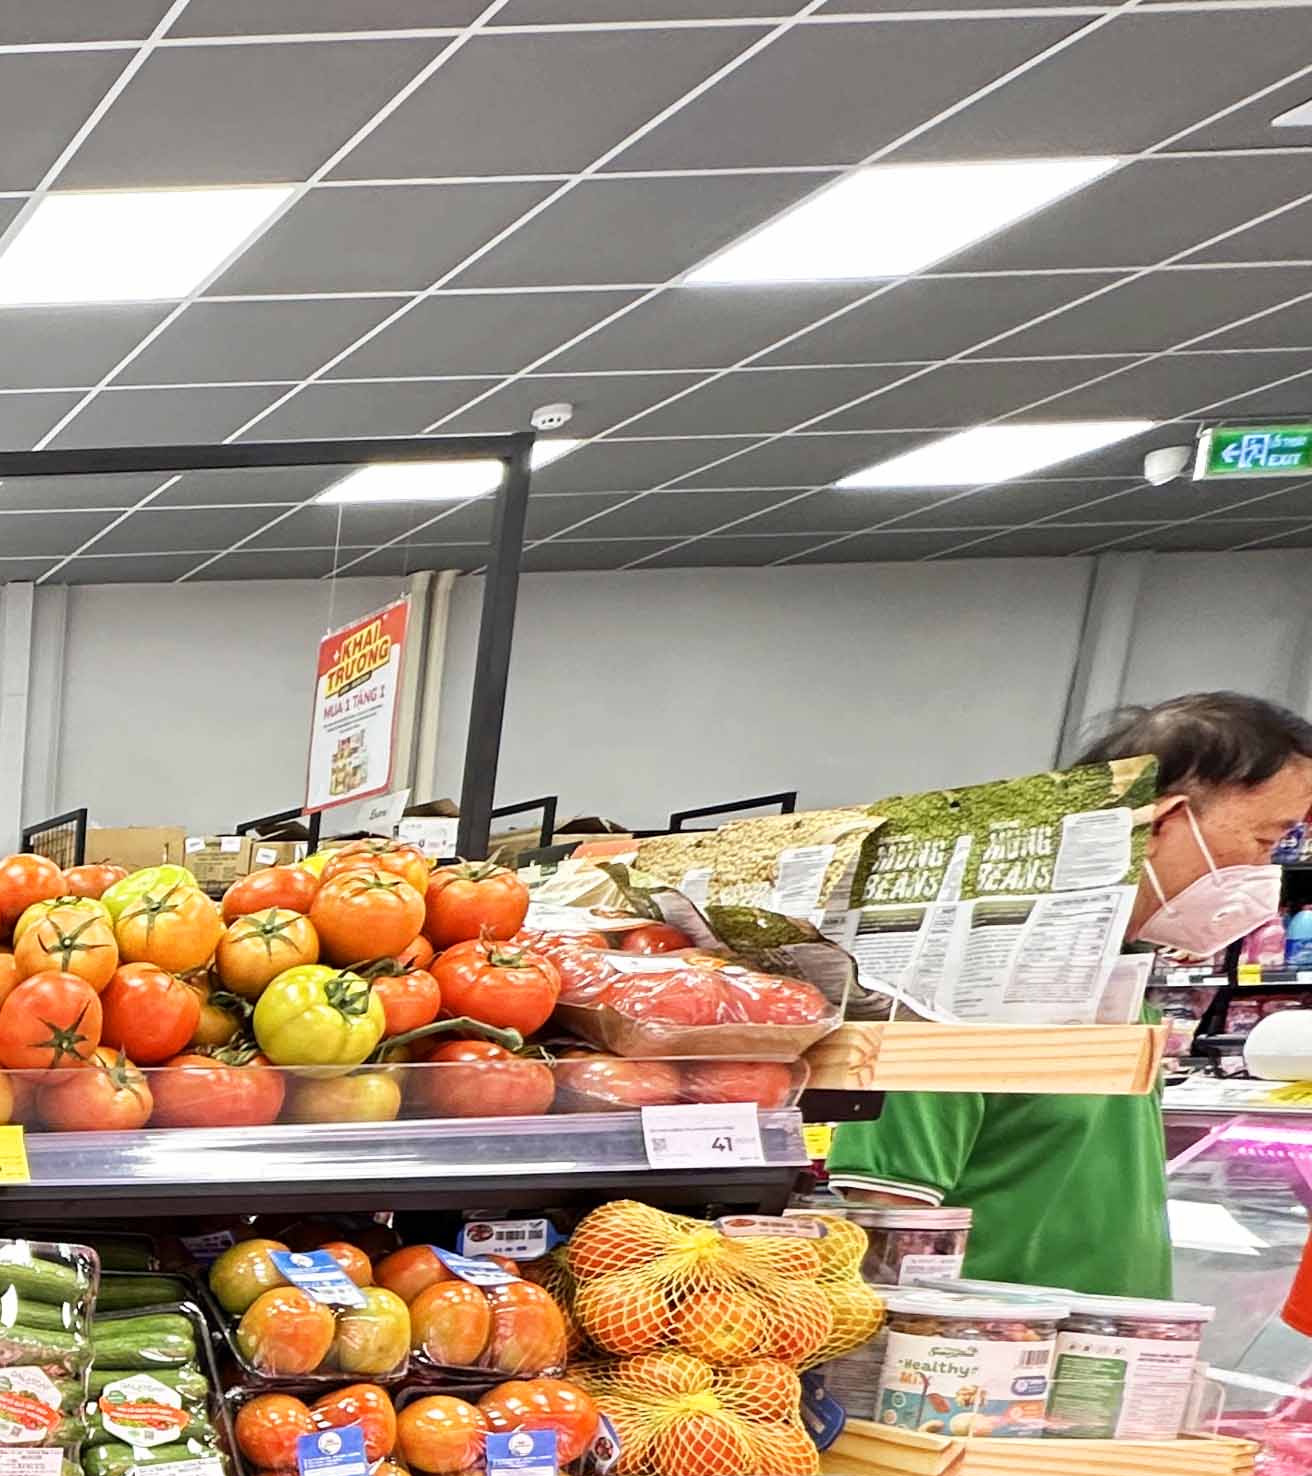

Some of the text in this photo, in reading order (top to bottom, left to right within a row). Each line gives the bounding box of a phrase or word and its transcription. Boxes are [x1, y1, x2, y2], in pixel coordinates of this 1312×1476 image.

[1268, 454, 1302, 467] EXIT
[342, 623, 379, 660] KHAI
[324, 701, 343, 718] MUA
[983, 828, 1054, 862] MUNG
[864, 869, 941, 899] BEANS
[976, 859, 1052, 890] BEANS
[711, 1136, 733, 1152] 41
[903, 1358, 970, 1378] Healthy
